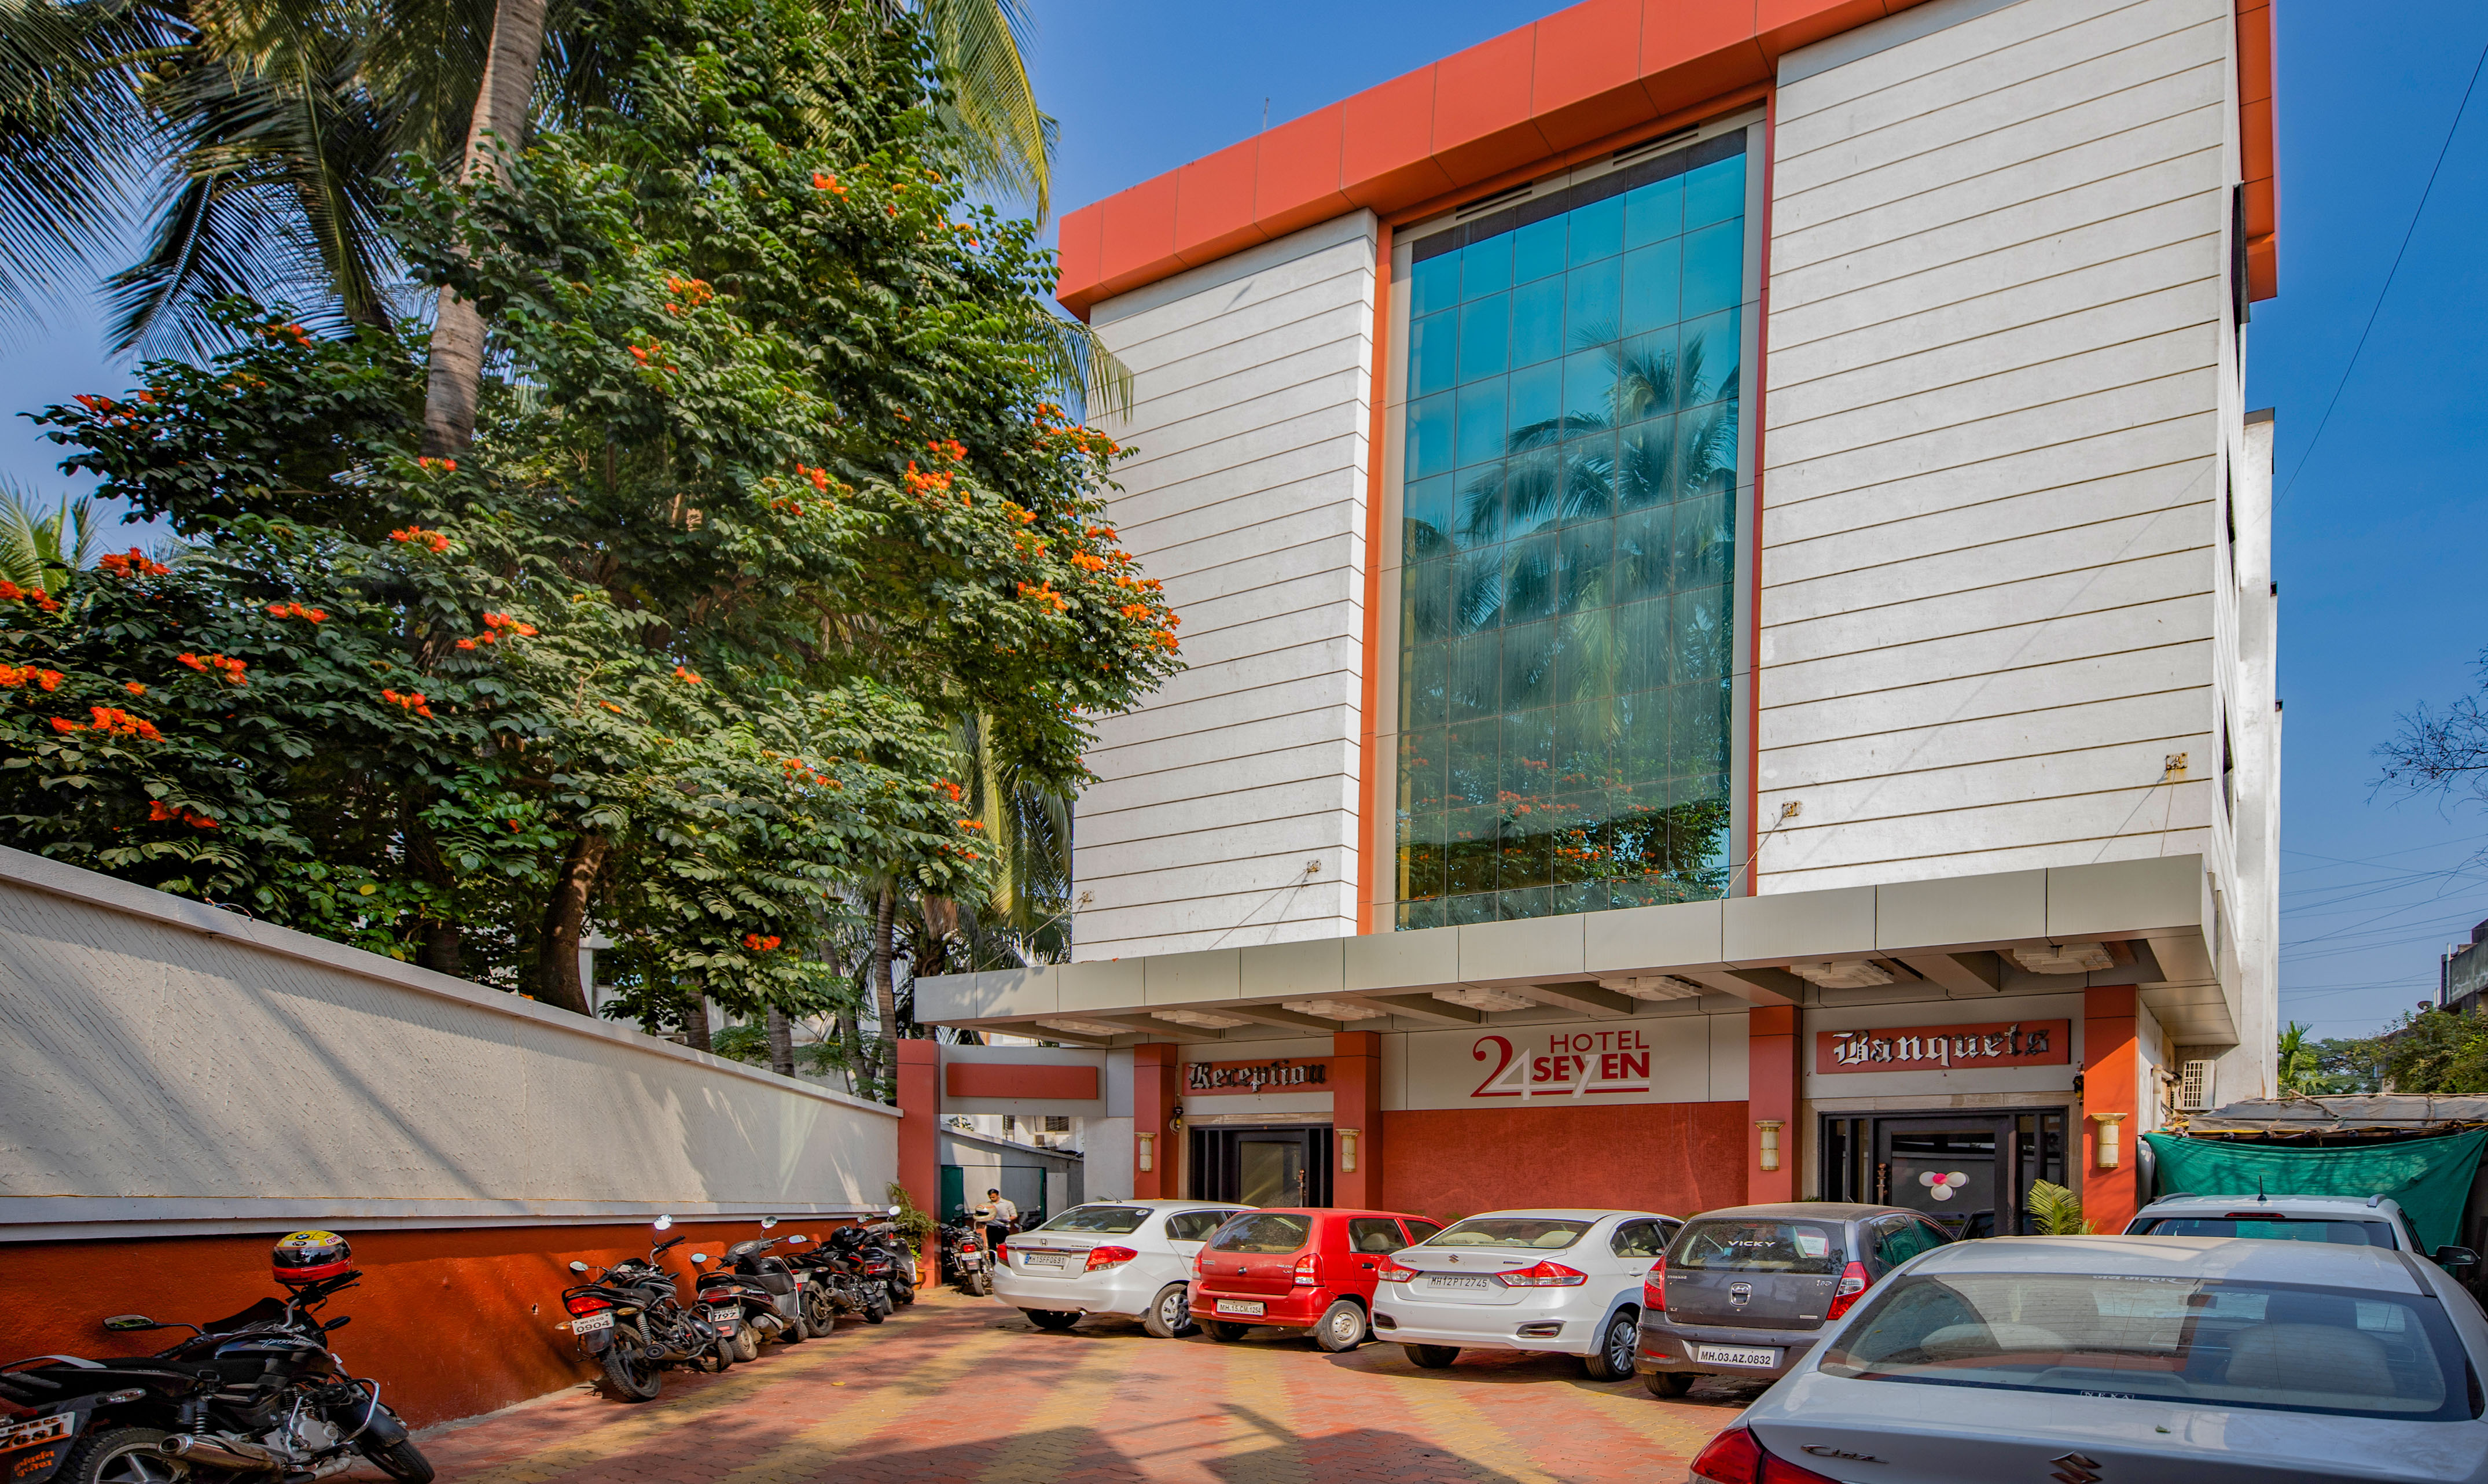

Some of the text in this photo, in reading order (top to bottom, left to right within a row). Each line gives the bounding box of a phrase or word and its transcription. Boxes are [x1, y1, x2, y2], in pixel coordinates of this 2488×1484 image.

[1550, 1030, 1650, 1054] HOTEL
[1832, 1023, 2049, 1068] Banquets
[1188, 1059, 1326, 1093] Reception
[1470, 1035, 1531, 1100] 24
[1219, 1304, 1261, 1314] MH.15.CM.1254
[576, 1320, 611, 1332] 0904
[1701, 1352, 1771, 1364] MH.03.AZ.0832
[0, 1422, 67, 1449] 7681
[1800, 1443, 1890, 1464] Ciaz
